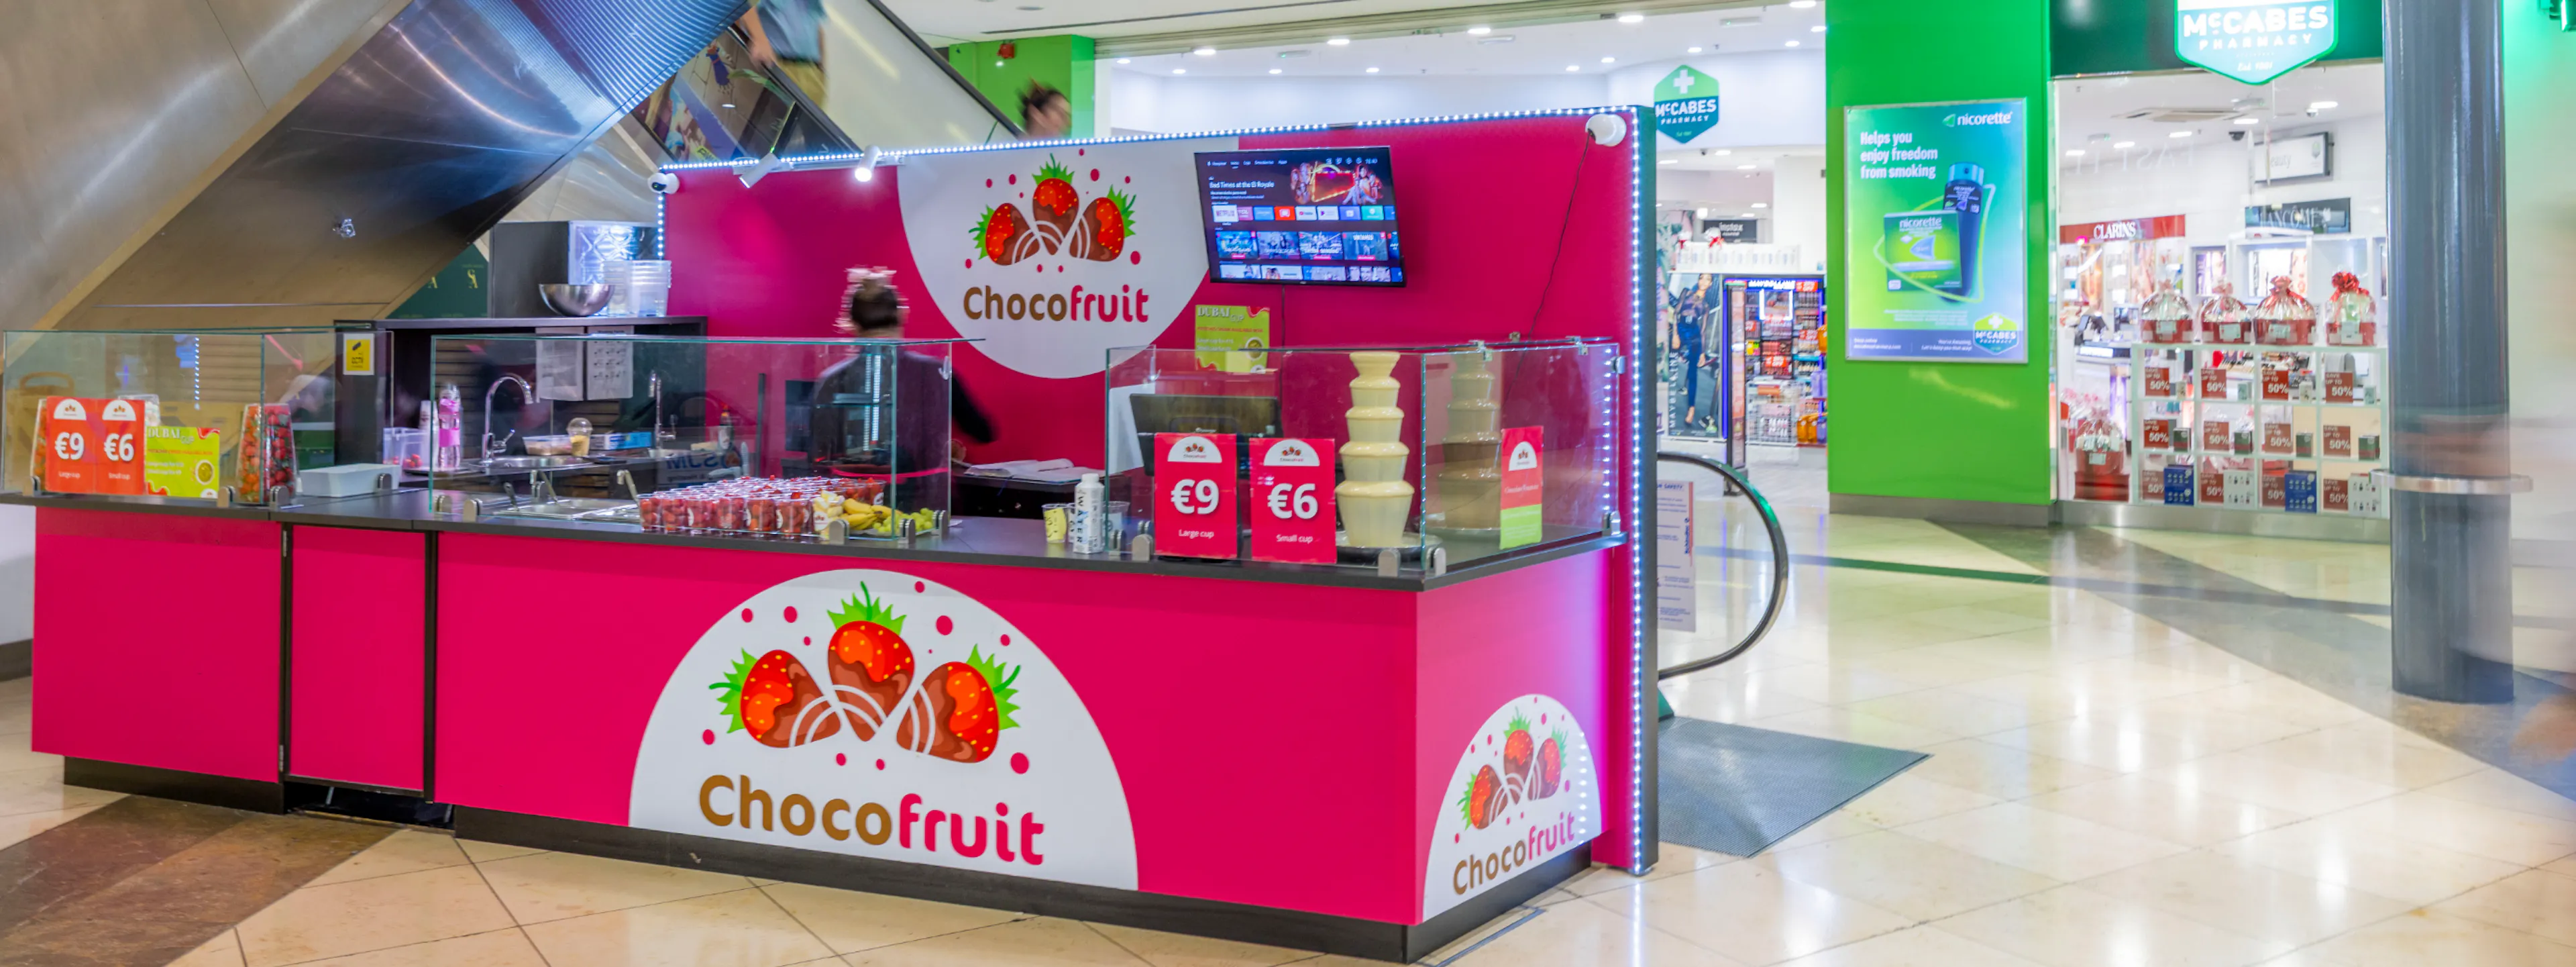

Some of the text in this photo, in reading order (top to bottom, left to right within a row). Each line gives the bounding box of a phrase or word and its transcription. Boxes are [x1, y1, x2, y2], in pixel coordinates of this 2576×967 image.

[2199, 34, 2312, 50] PHARMACY
[1660, 115, 1709, 125] PHARMACY
[1957, 111, 2012, 125] nicorette
[1860, 130, 1913, 148] Helps you
[1860, 146, 1938, 164] enjoy freedom
[1860, 164, 1936, 180] from smoking
[1899, 216, 1942, 227] nicorette
[2094, 221, 2137, 240] CLARINS
[963, 284, 1150, 323] Chocofruit
[1197, 307, 1230, 317] DUBAI
[2150, 380, 2170, 391] 50%
[2206, 382, 2226, 392] 50%
[2267, 383, 2289, 394] 50%
[2331, 386, 2353, 397] 50%
[148, 427, 180, 439] DUBAI
[2149, 432, 2169, 442] 50%
[2209, 434, 2229, 444] 50%
[54, 431, 85, 460] €9
[104, 433, 135, 462] €6
[2270, 437, 2292, 447] 50%
[2329, 439, 2351, 450] 50%
[1171, 478, 1220, 515] €9
[1267, 482, 1319, 519] €6
[1077, 495, 1085, 543] WATER
[1179, 529, 1214, 539] Large cup
[1276, 534, 1313, 544] Small cup
[699, 774, 1044, 866] Chocofruit
[1453, 811, 1575, 895] Chocofruit
